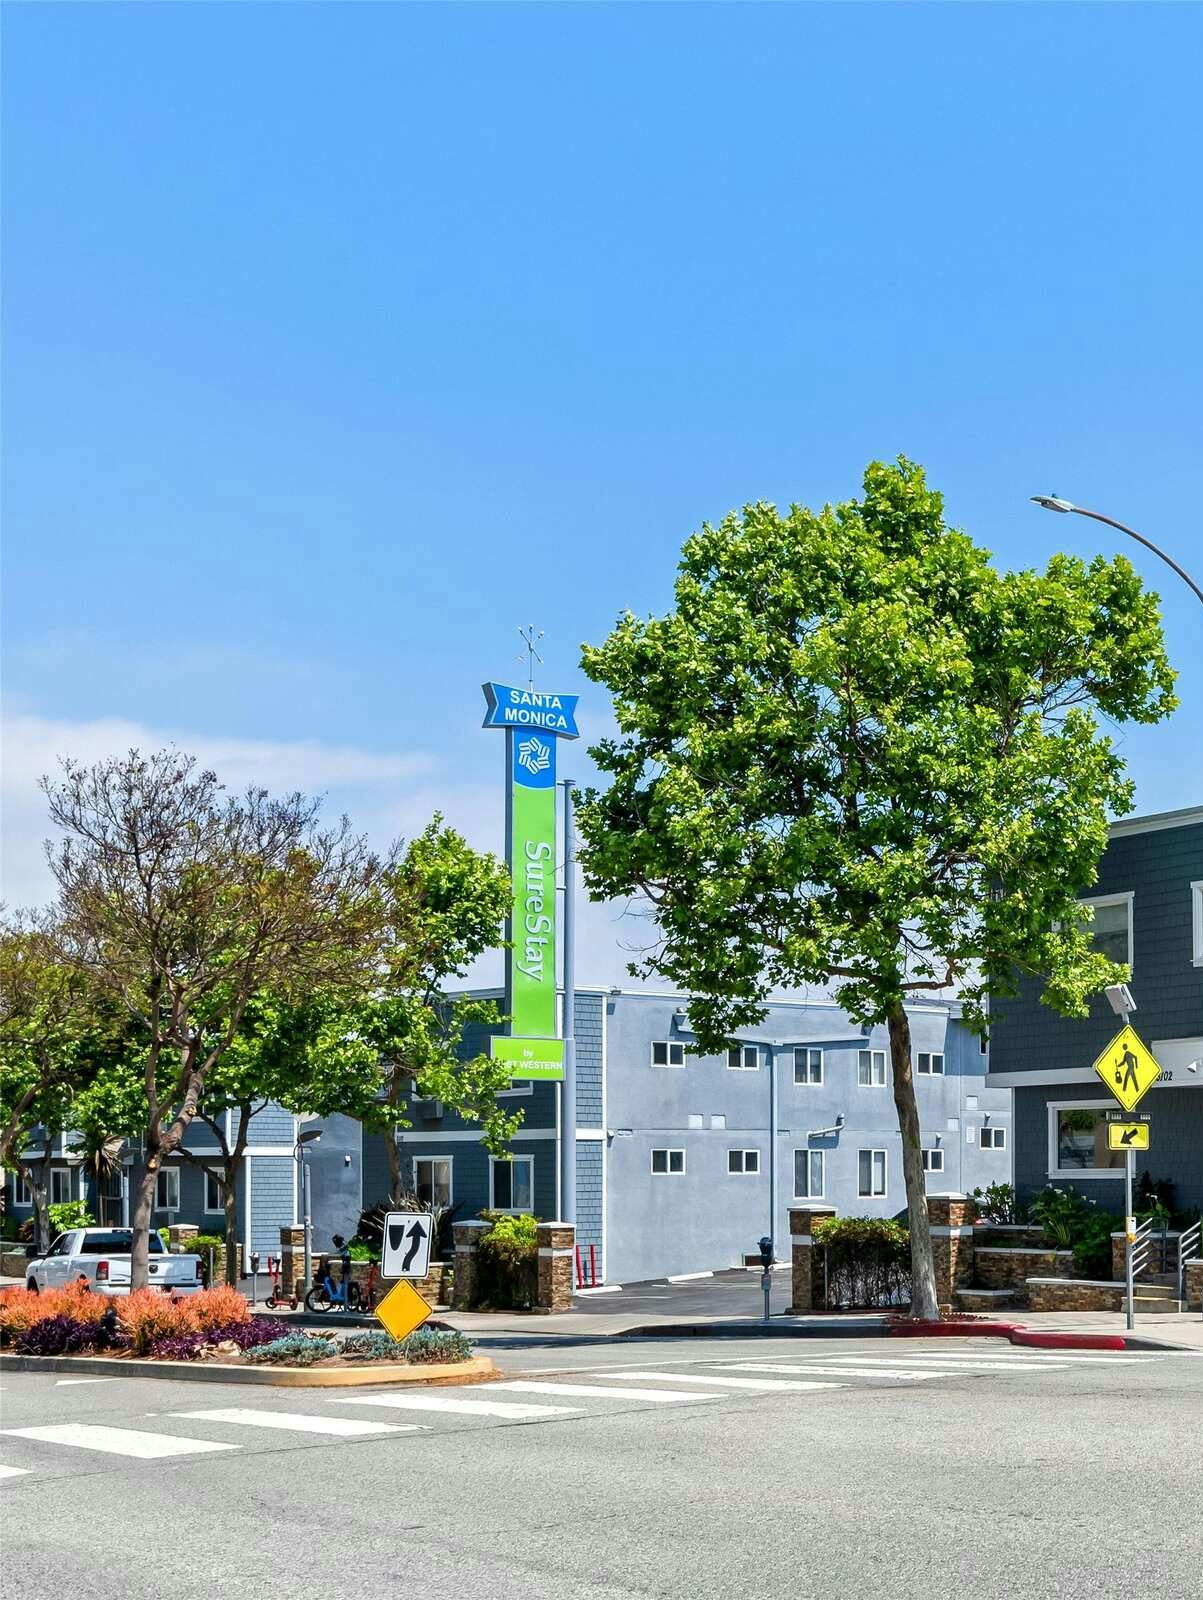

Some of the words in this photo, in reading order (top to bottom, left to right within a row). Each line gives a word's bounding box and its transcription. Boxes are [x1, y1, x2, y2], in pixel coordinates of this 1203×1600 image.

[510, 690, 562, 710] SANTA
[505, 707, 568, 728] MONICA
[516, 840, 552, 982] SureStay
[523, 1048, 534, 1058] by
[520, 1060, 563, 1070] WESTERN
